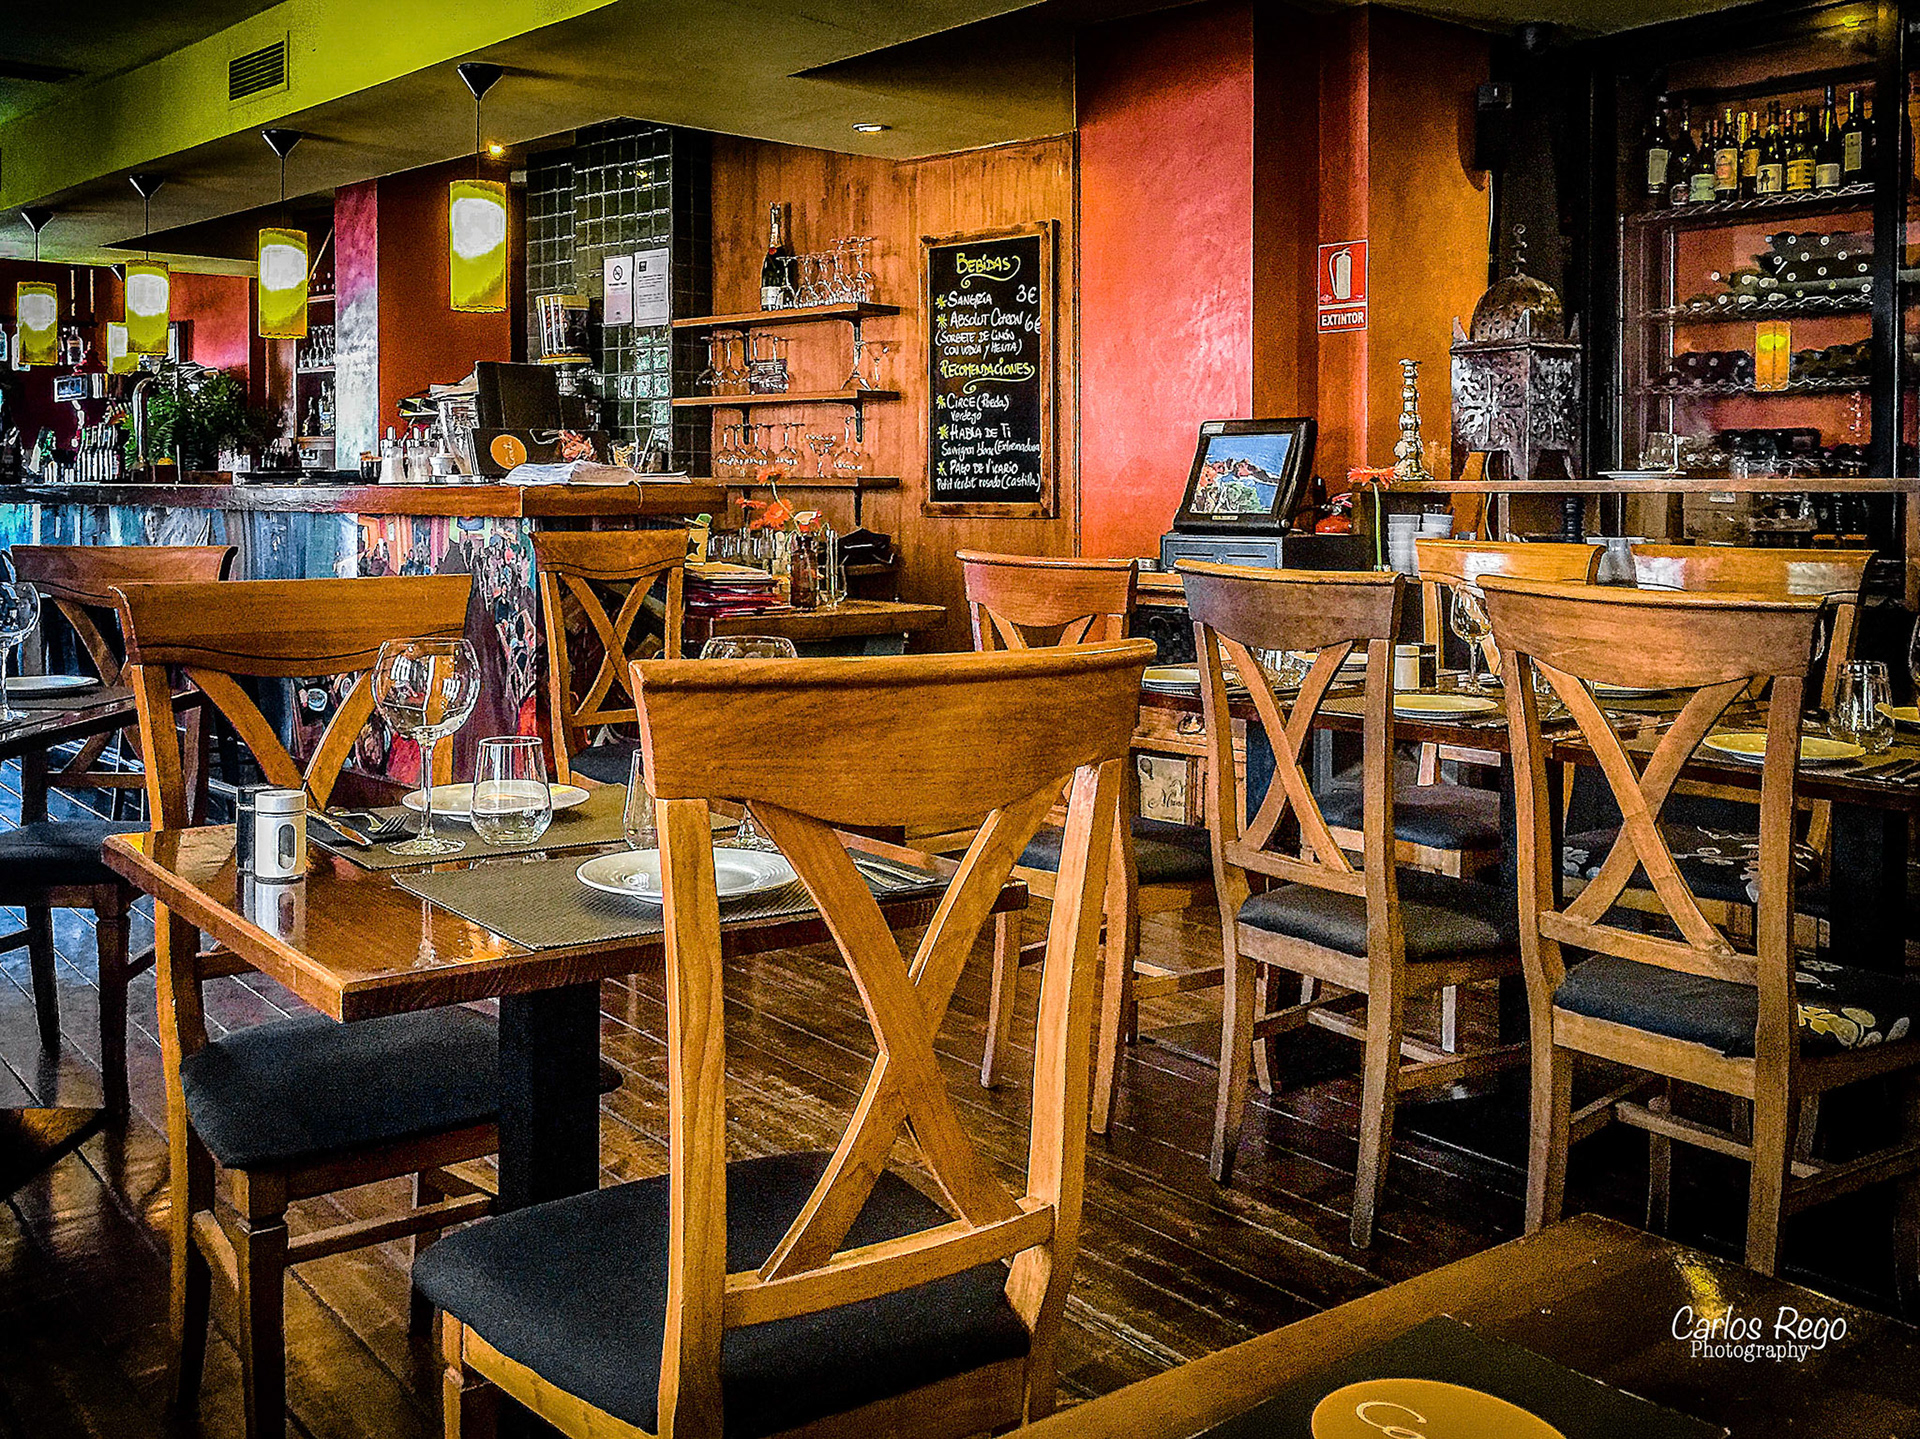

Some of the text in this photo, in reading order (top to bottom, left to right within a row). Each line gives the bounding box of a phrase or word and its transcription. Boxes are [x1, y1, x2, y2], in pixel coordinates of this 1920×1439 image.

[950, 311, 990, 329] ABSOLUT
[1321, 311, 1365, 327] EXTINTOR
[978, 330, 990, 342] DE
[949, 424, 982, 440] HABLA
[984, 427, 998, 439] DE
